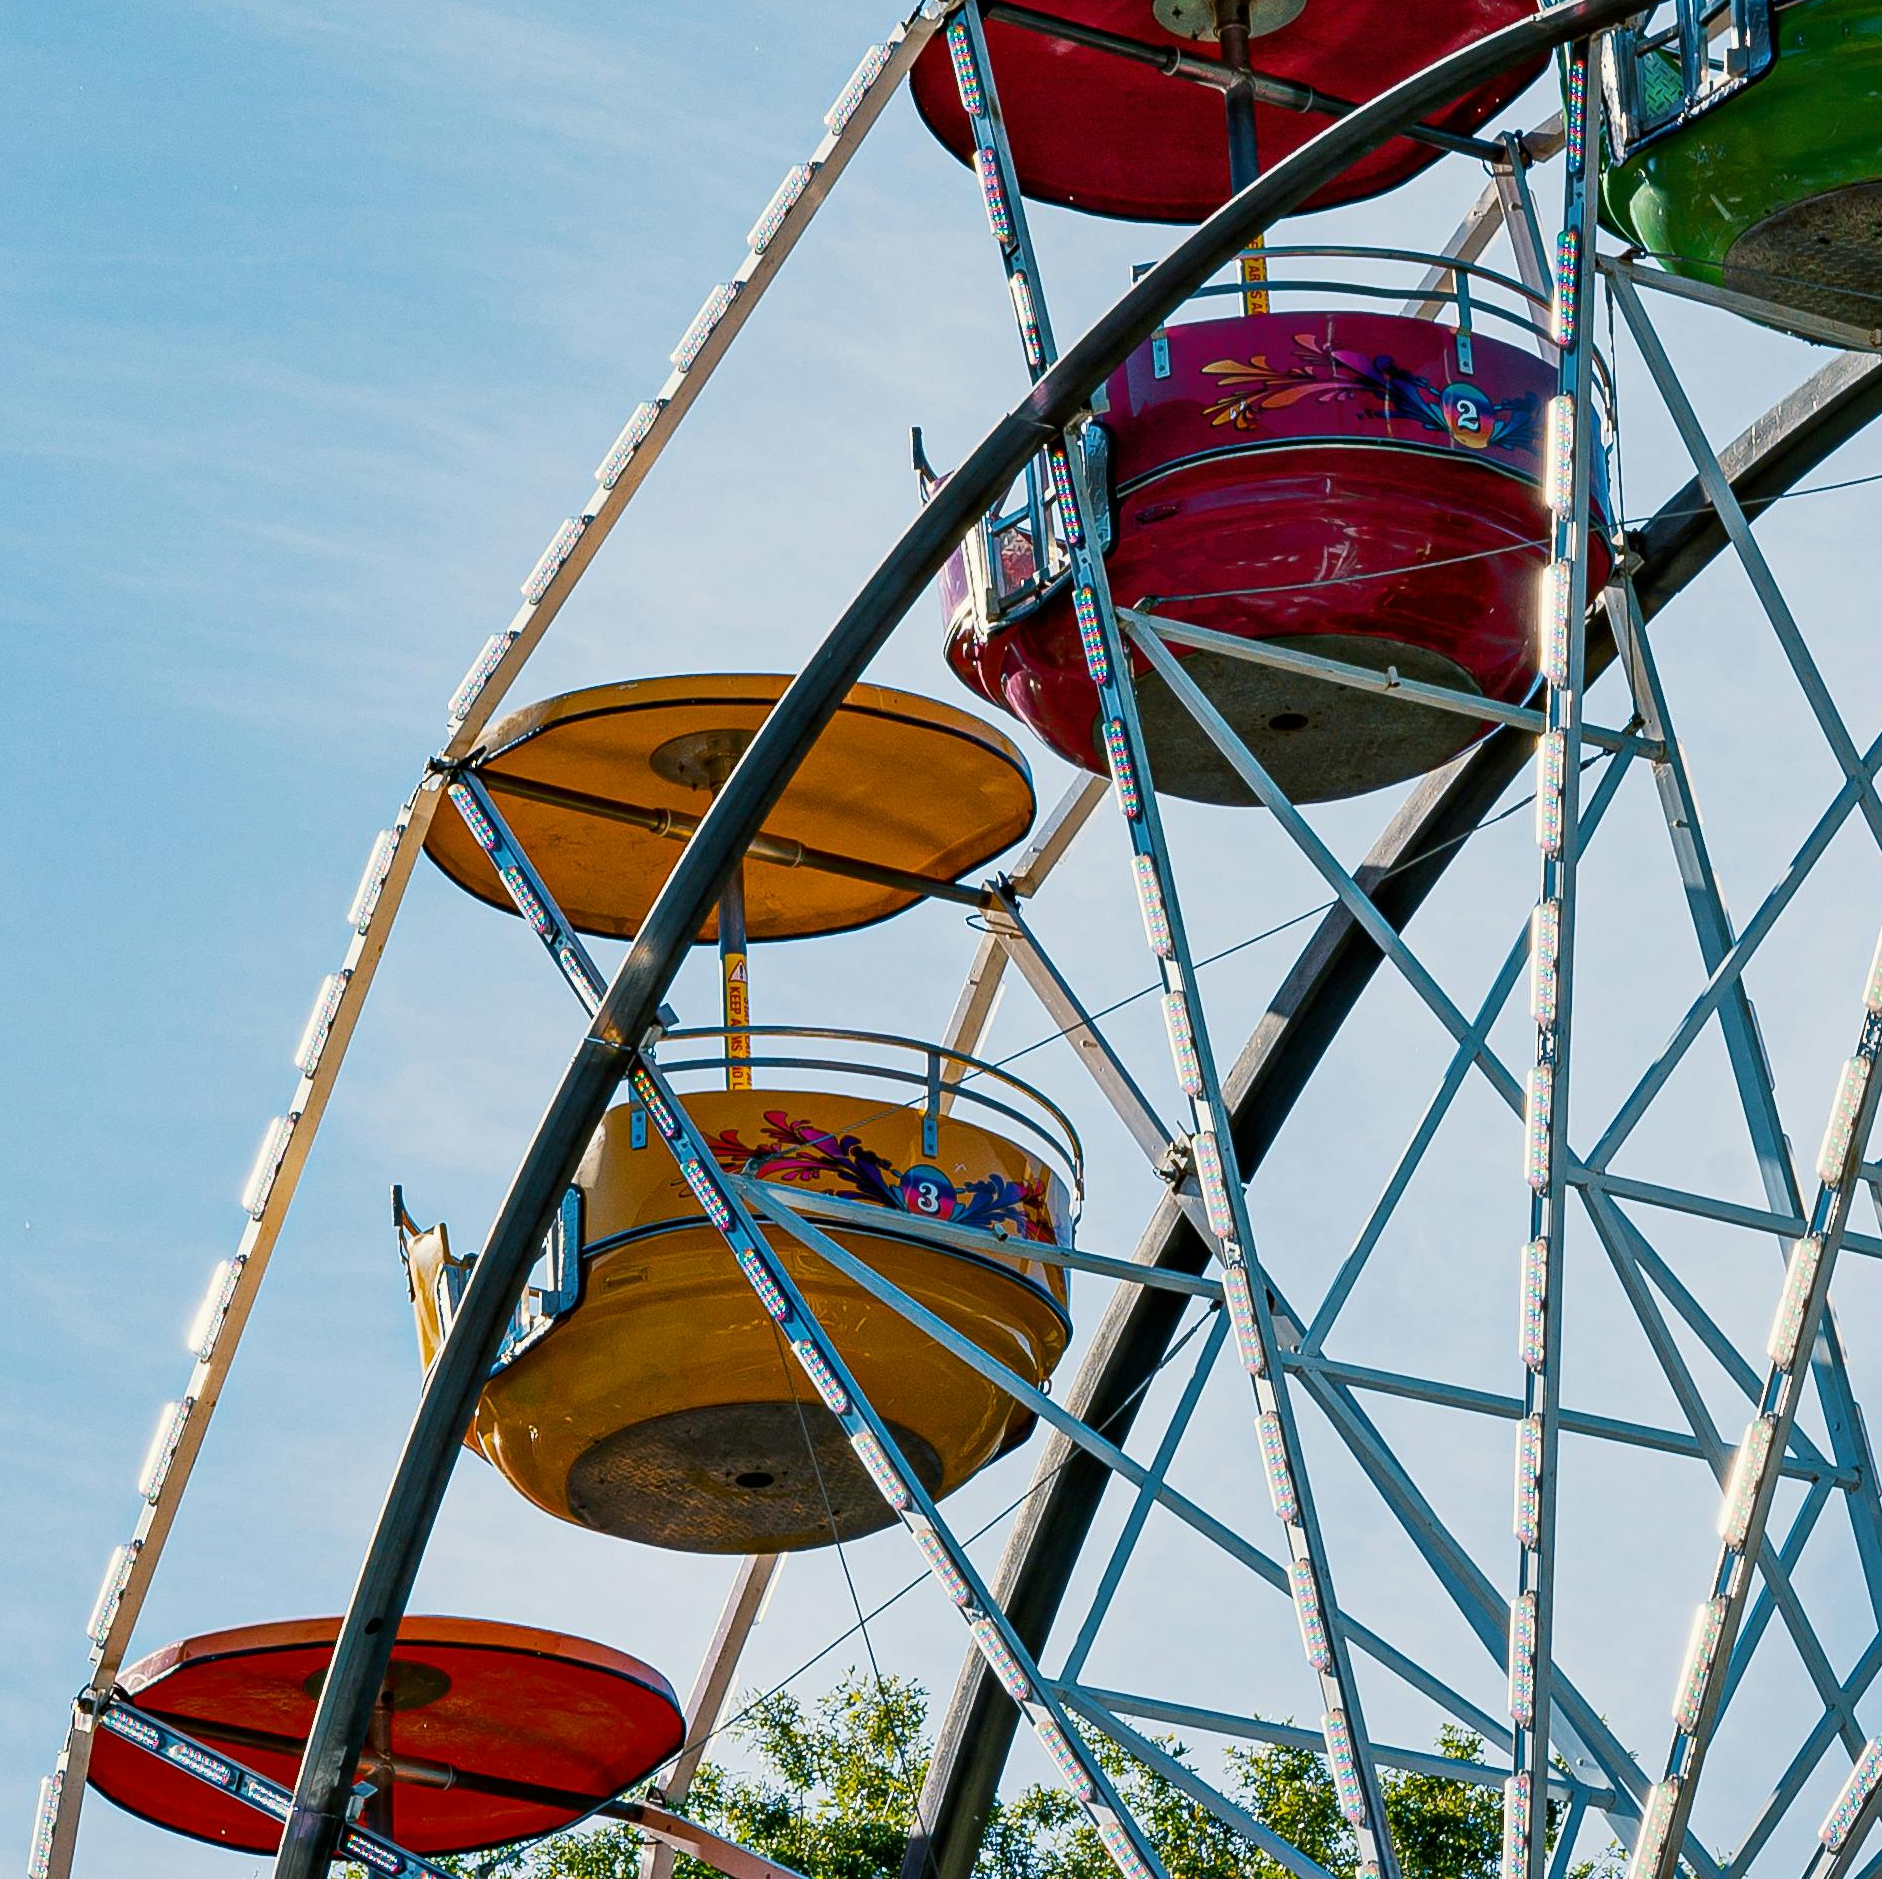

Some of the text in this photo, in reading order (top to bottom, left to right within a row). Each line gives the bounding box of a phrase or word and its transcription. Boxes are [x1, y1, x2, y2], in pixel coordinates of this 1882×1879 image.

[1248, 266, 1263, 300] ARS
[1457, 399, 1479, 431] 2
[729, 986, 742, 1015] KEEP
[730, 1018, 744, 1052] AMS
[917, 1182, 940, 1213] 3
